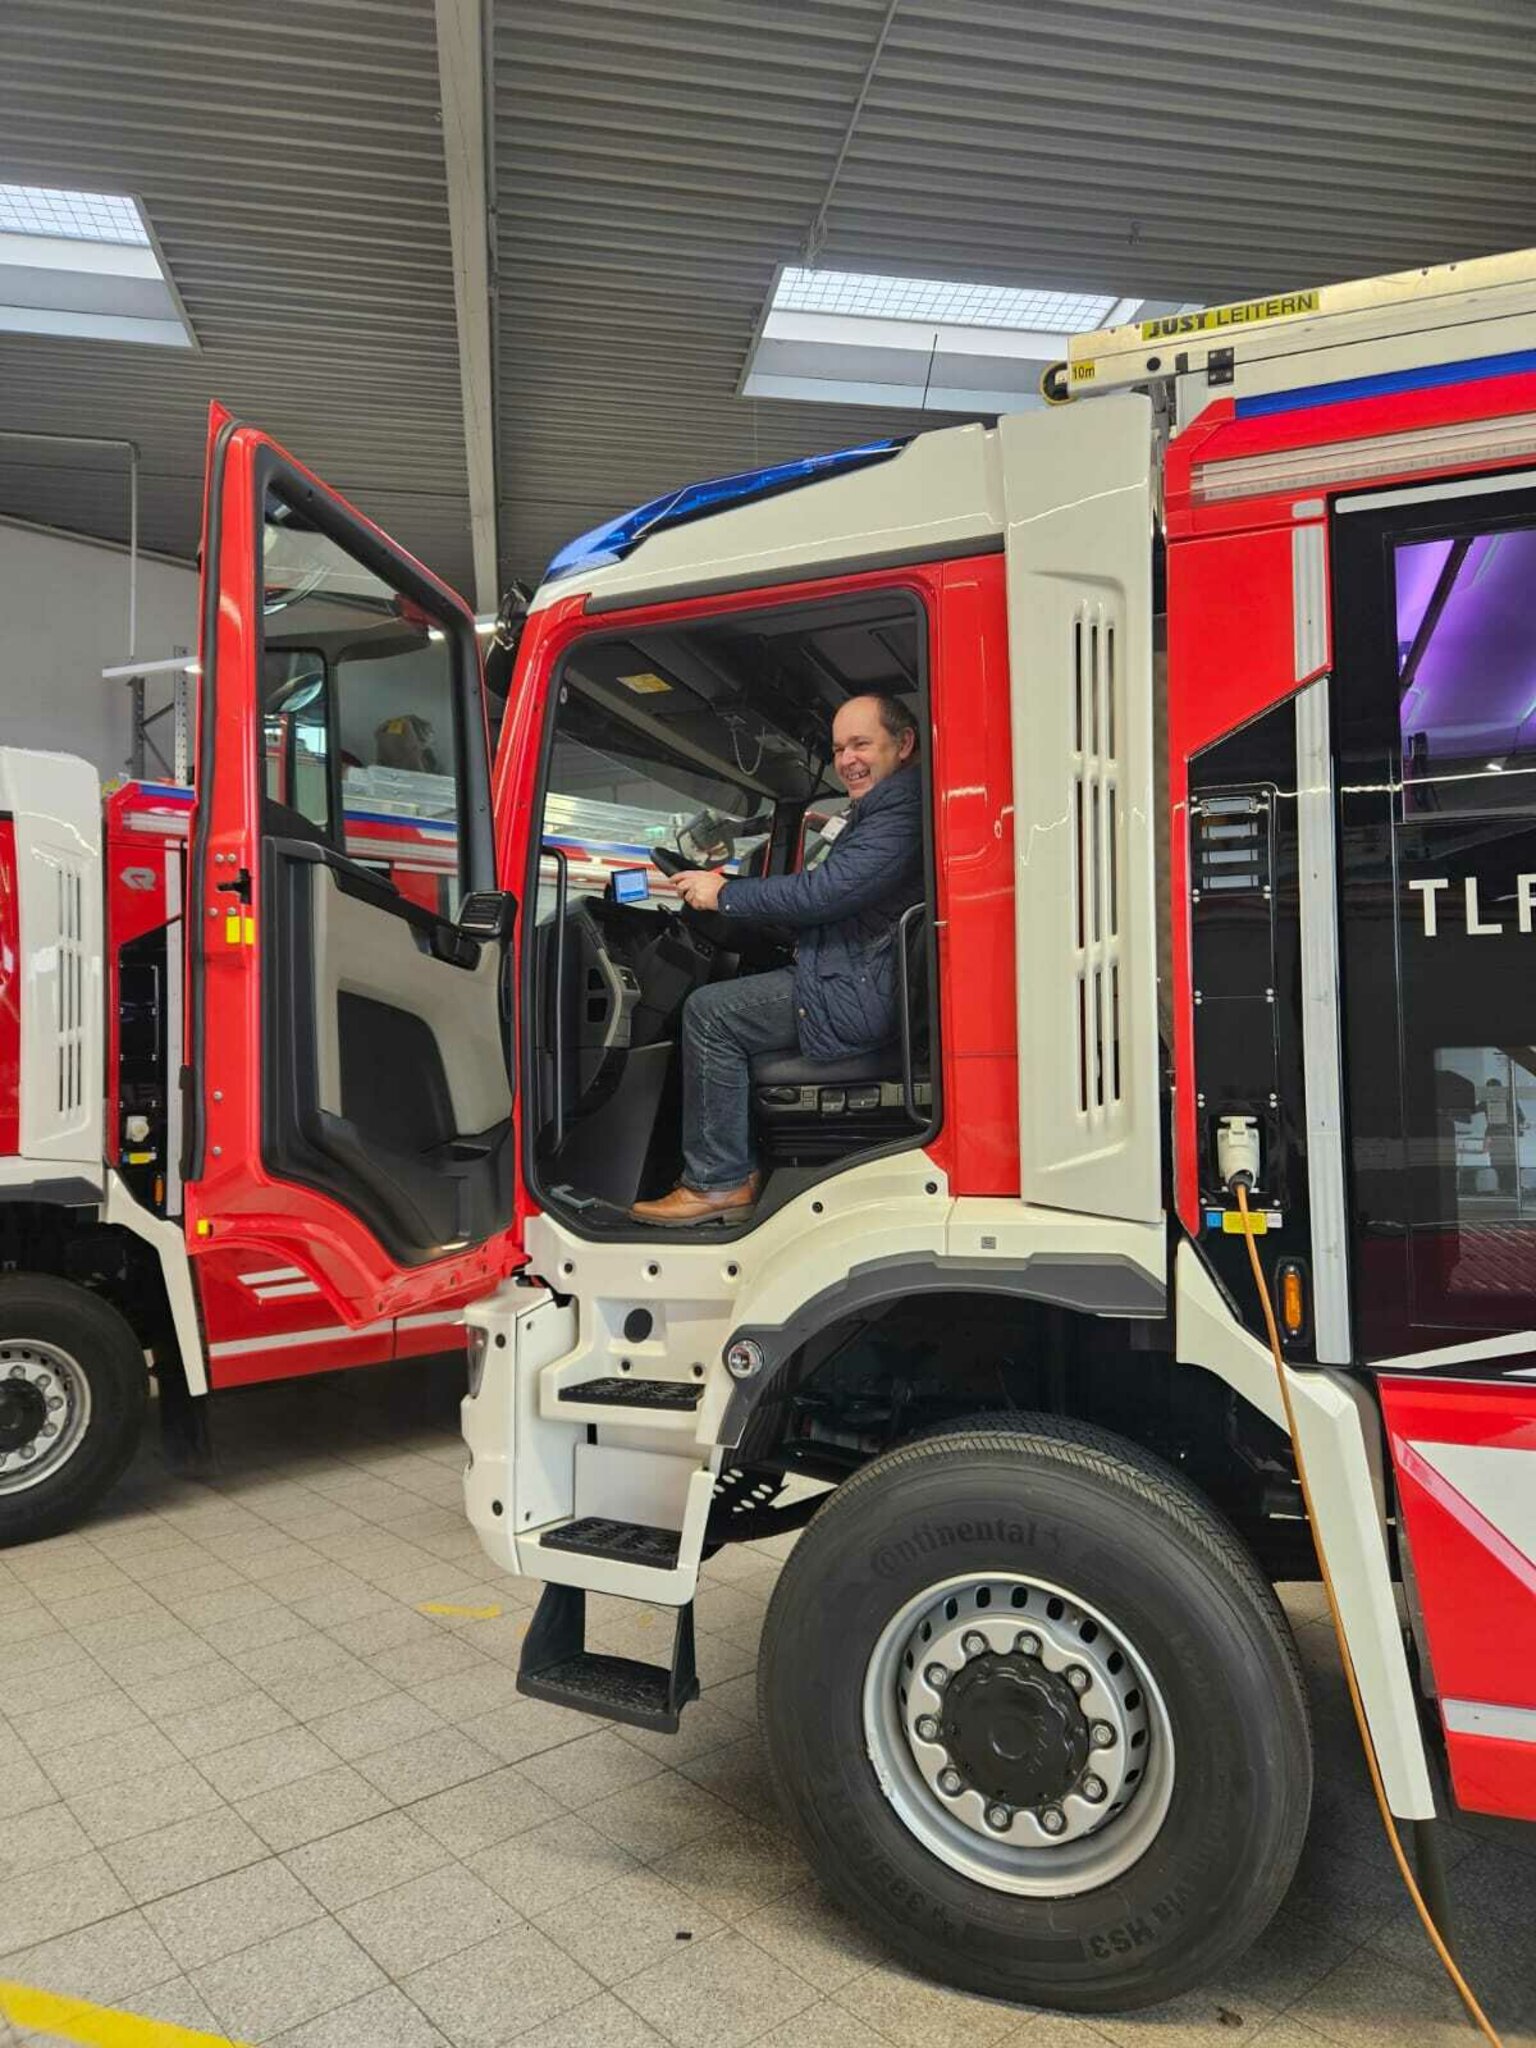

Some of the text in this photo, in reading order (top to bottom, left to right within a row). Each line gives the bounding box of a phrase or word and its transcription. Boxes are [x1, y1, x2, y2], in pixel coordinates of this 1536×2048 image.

[1149, 294, 1314, 339] JUST LEITERN
[1072, 365, 1096, 380] 10m
[870, 1517, 1039, 1580] Continental
